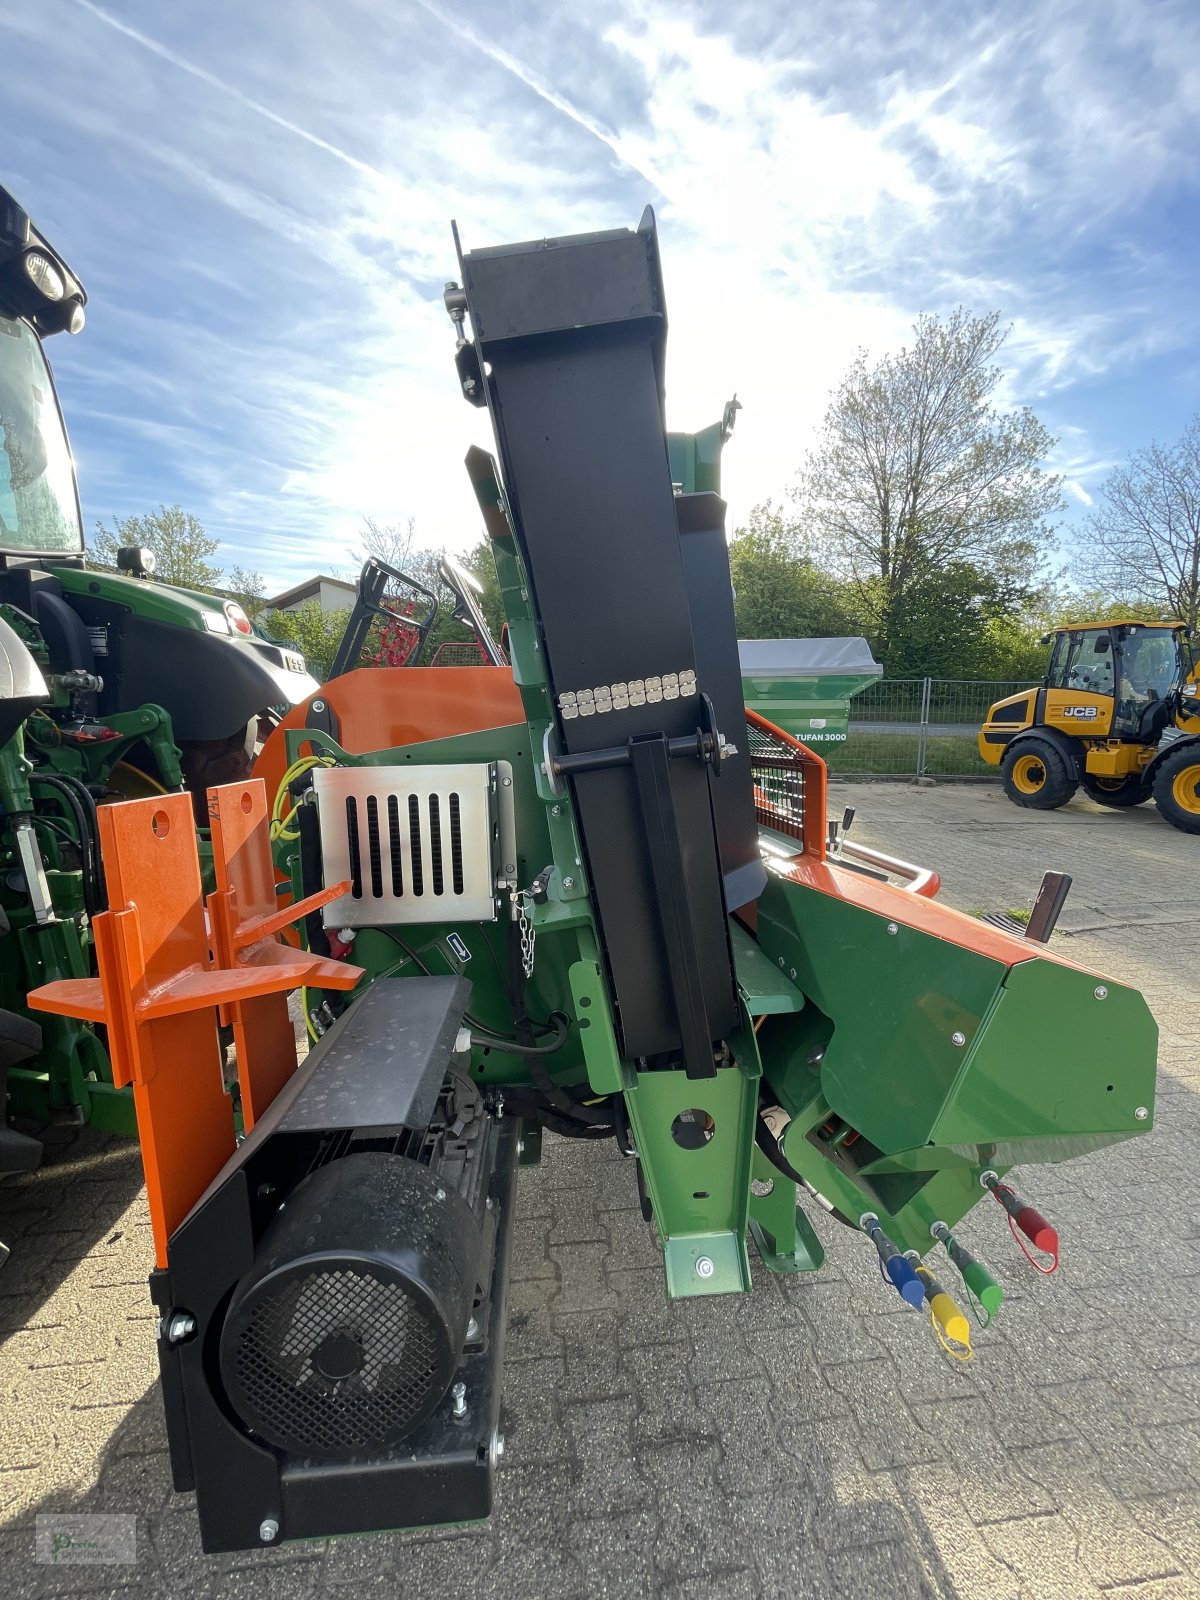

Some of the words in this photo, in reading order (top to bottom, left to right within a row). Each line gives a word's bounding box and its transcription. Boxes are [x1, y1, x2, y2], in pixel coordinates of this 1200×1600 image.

[1064, 707, 1097, 717] JCB
[795, 733, 824, 741] TUFAN
[825, 733, 847, 741] 3000
